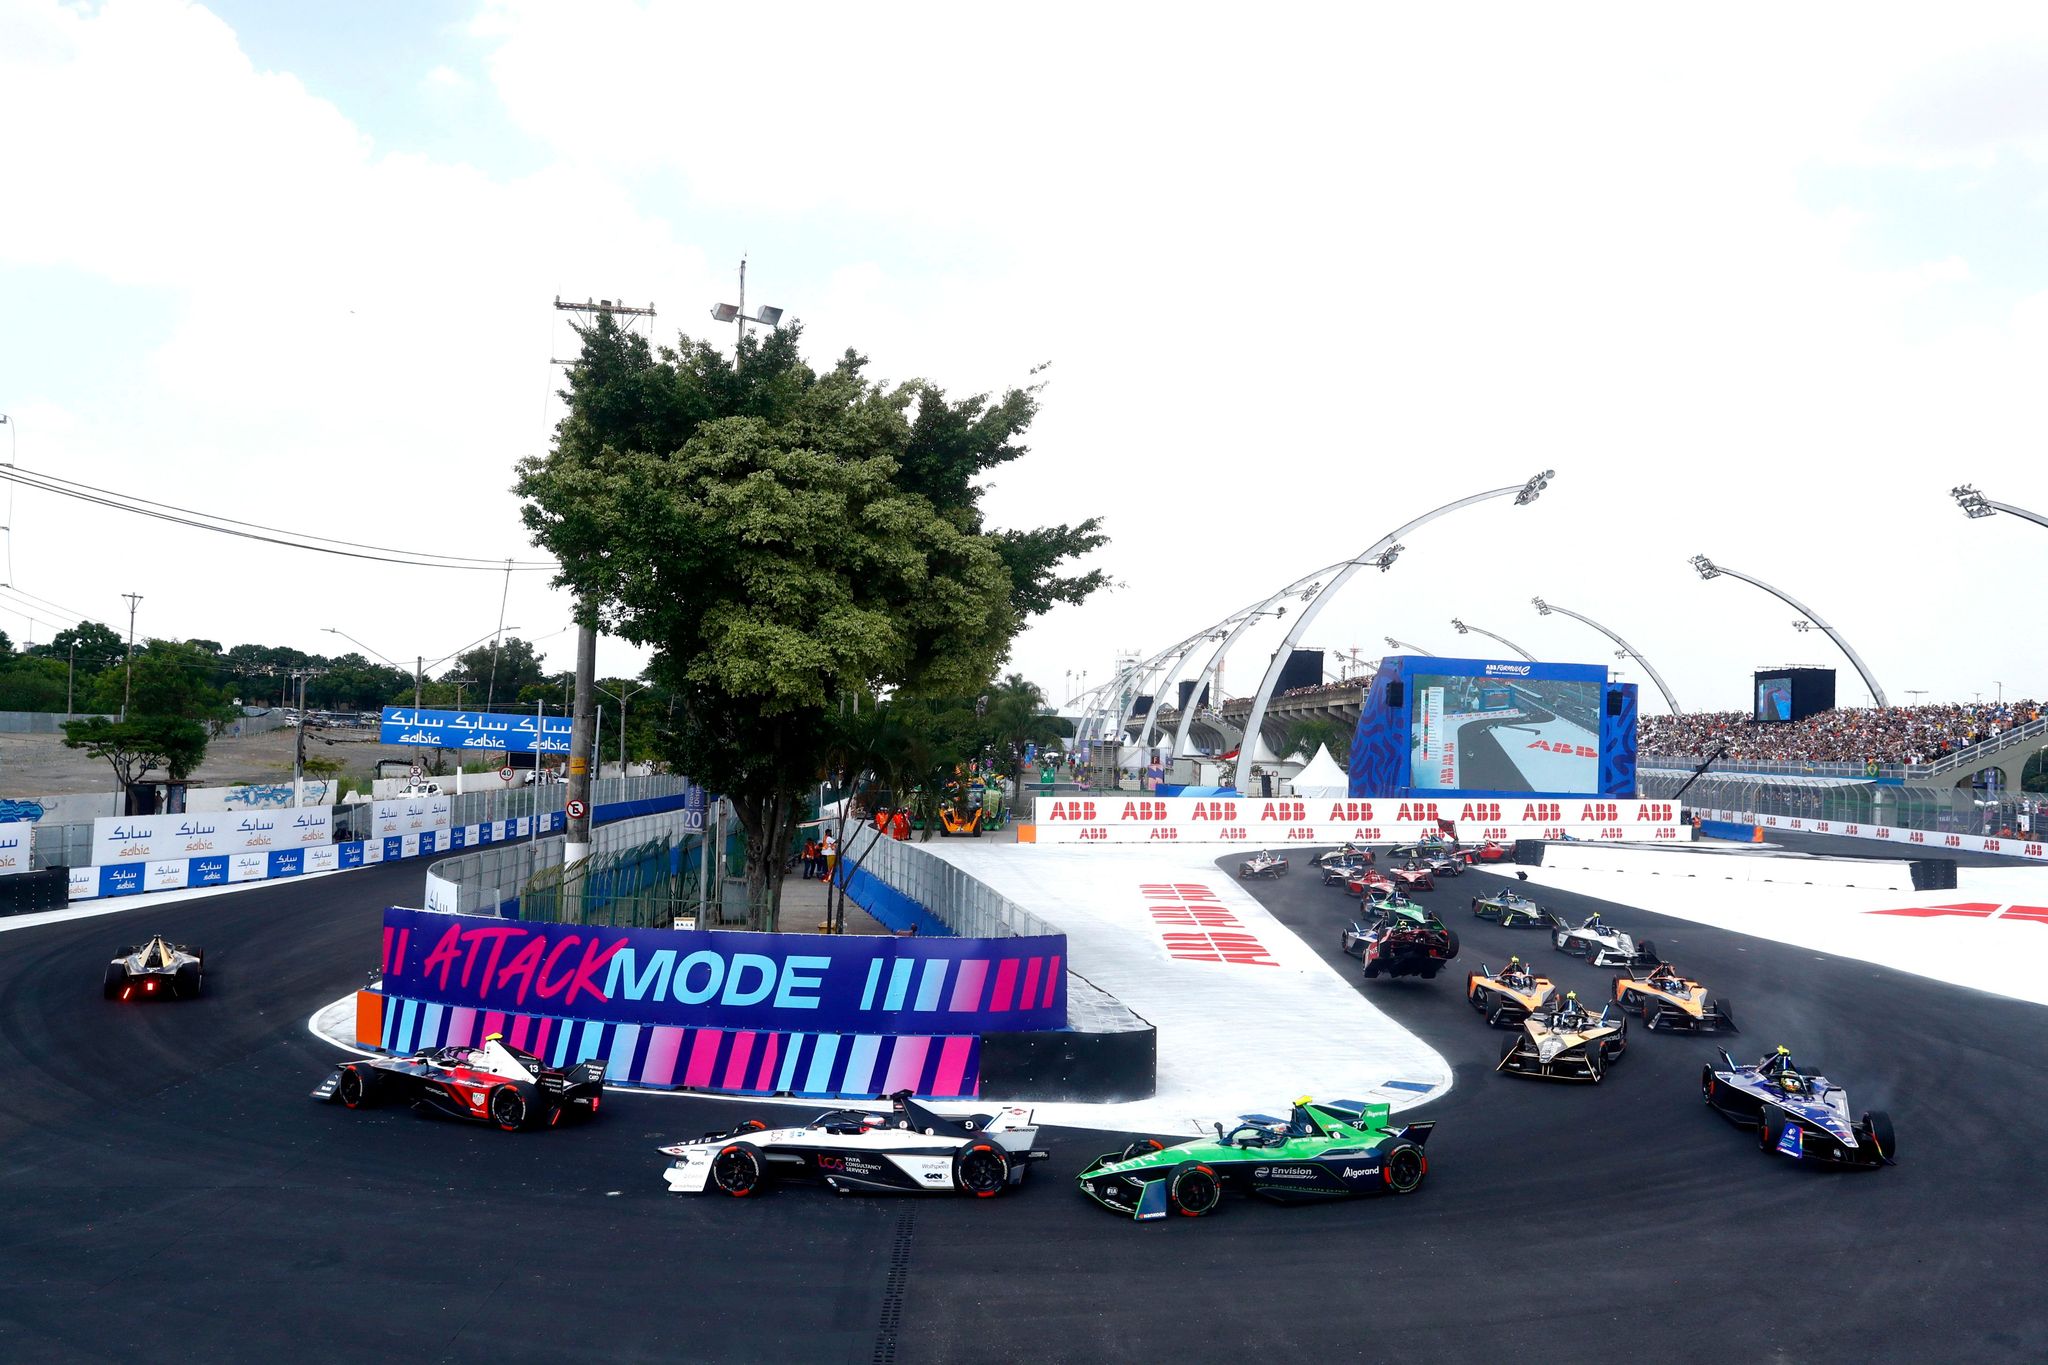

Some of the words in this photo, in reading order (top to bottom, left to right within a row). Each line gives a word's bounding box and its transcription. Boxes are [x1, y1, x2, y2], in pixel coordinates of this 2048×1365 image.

[384, 711, 444, 730] سابك
[448, 714, 508, 734] سابك
[398, 730, 441, 744] sabic
[462, 734, 506, 748] sabic
[1527, 740, 1598, 758] ABB
[502, 770, 512, 778] 40
[1050, 802, 1096, 820] ABB
[1121, 802, 1168, 820] ABB
[1192, 802, 1237, 820] ABB
[1261, 802, 1306, 821] ABB
[1330, 802, 1373, 821] ABB
[1397, 803, 1439, 821] ABB
[1461, 803, 1501, 821] ABB
[1522, 804, 1561, 821] ABB
[1581, 804, 1618, 821] ABB
[1637, 804, 1672, 821] ABB
[236, 818, 274, 834] سابك
[293, 814, 326, 830] سابك
[685, 812, 702, 828] 20
[108, 825, 152, 844] سابك
[176, 821, 215, 838] سابك
[1080, 828, 1108, 839] ABB
[1150, 828, 1177, 839] ABB
[1220, 828, 1247, 839] ABB
[1288, 828, 1314, 839] ABB
[1354, 828, 1380, 839] ABB
[1483, 828, 1507, 839] ABB
[1601, 828, 1622, 838] ABB
[1655, 828, 1676, 838] ABB
[1766, 817, 1776, 826] ABB
[1791, 819, 1802, 828] ABB
[1817, 822, 1828, 832] ABB
[1846, 825, 1858, 835] ABB
[1876, 828, 1890, 838] ABB
[1910, 832, 1924, 842] ABB
[1945, 836, 1960, 846] ABB
[1984, 840, 2000, 852] ABB
[2024, 844, 2042, 856] ABB
[119, 842, 150, 857] sabic
[184, 838, 213, 852] sabic
[246, 834, 272, 846] sabic
[301, 829, 324, 842] sabic
[276, 854, 298, 864] سابك
[110, 869, 136, 882] سابك
[154, 866, 180, 876] سابك
[197, 862, 222, 874] سابك
[69, 873, 89, 883] ساب
[424, 923, 629, 1006] ATTACK
[604, 949, 832, 1009] MODE
[529, 1064, 538, 1072] 13
[965, 1120, 974, 1130] 9
[1352, 1120, 1364, 1130] 37
[818, 1154, 844, 1171] tcs
[846, 1162, 882, 1170] CONSULTANCY
[1272, 1167, 1312, 1175] Envision
[1342, 1166, 1380, 1178] Algorand
